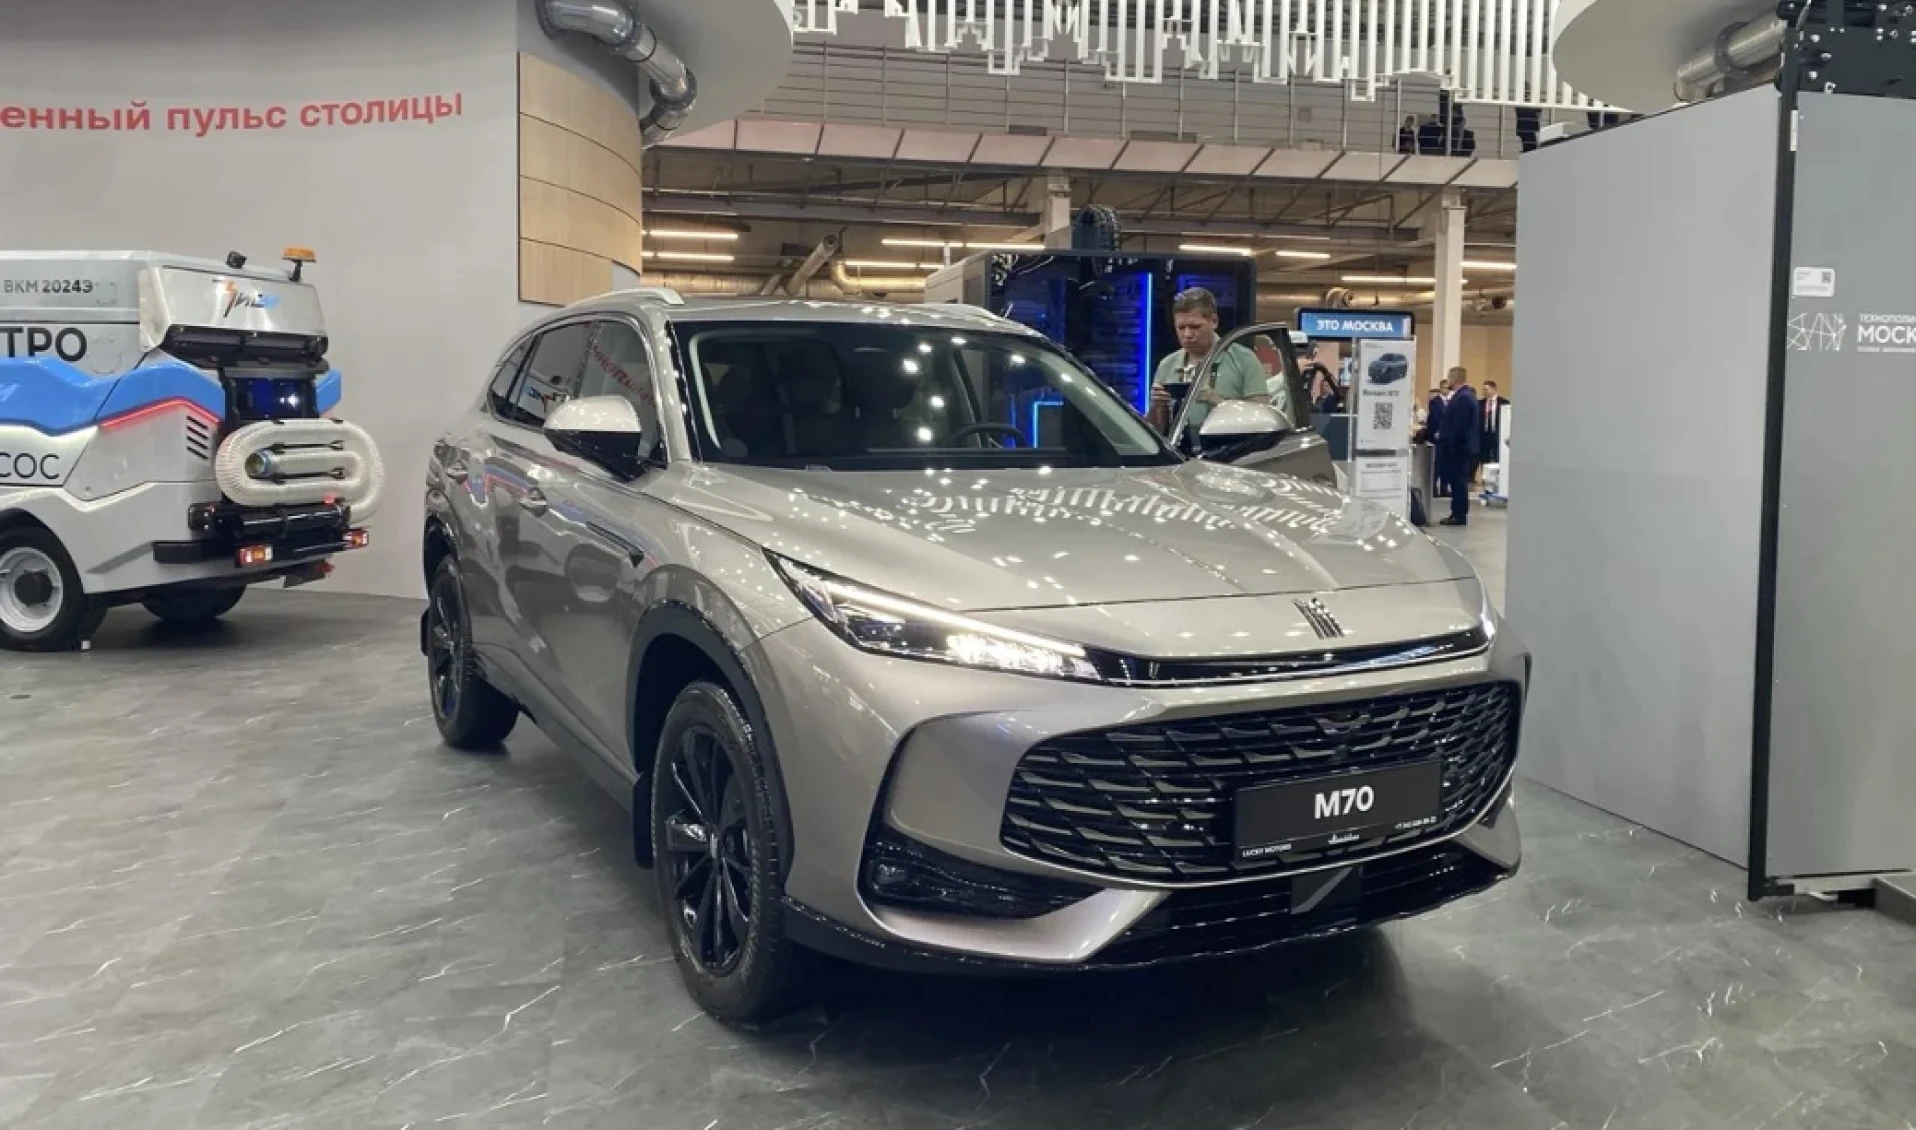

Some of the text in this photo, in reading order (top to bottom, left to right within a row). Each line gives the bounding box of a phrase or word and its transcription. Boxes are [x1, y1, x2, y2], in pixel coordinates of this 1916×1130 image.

[0, 92, 462, 138] енный пульс столицы
[1316, 320, 1394, 332] ЭТО МОСКВА
[0, 327, 88, 362] ТРО
[1314, 785, 1374, 819] M70
